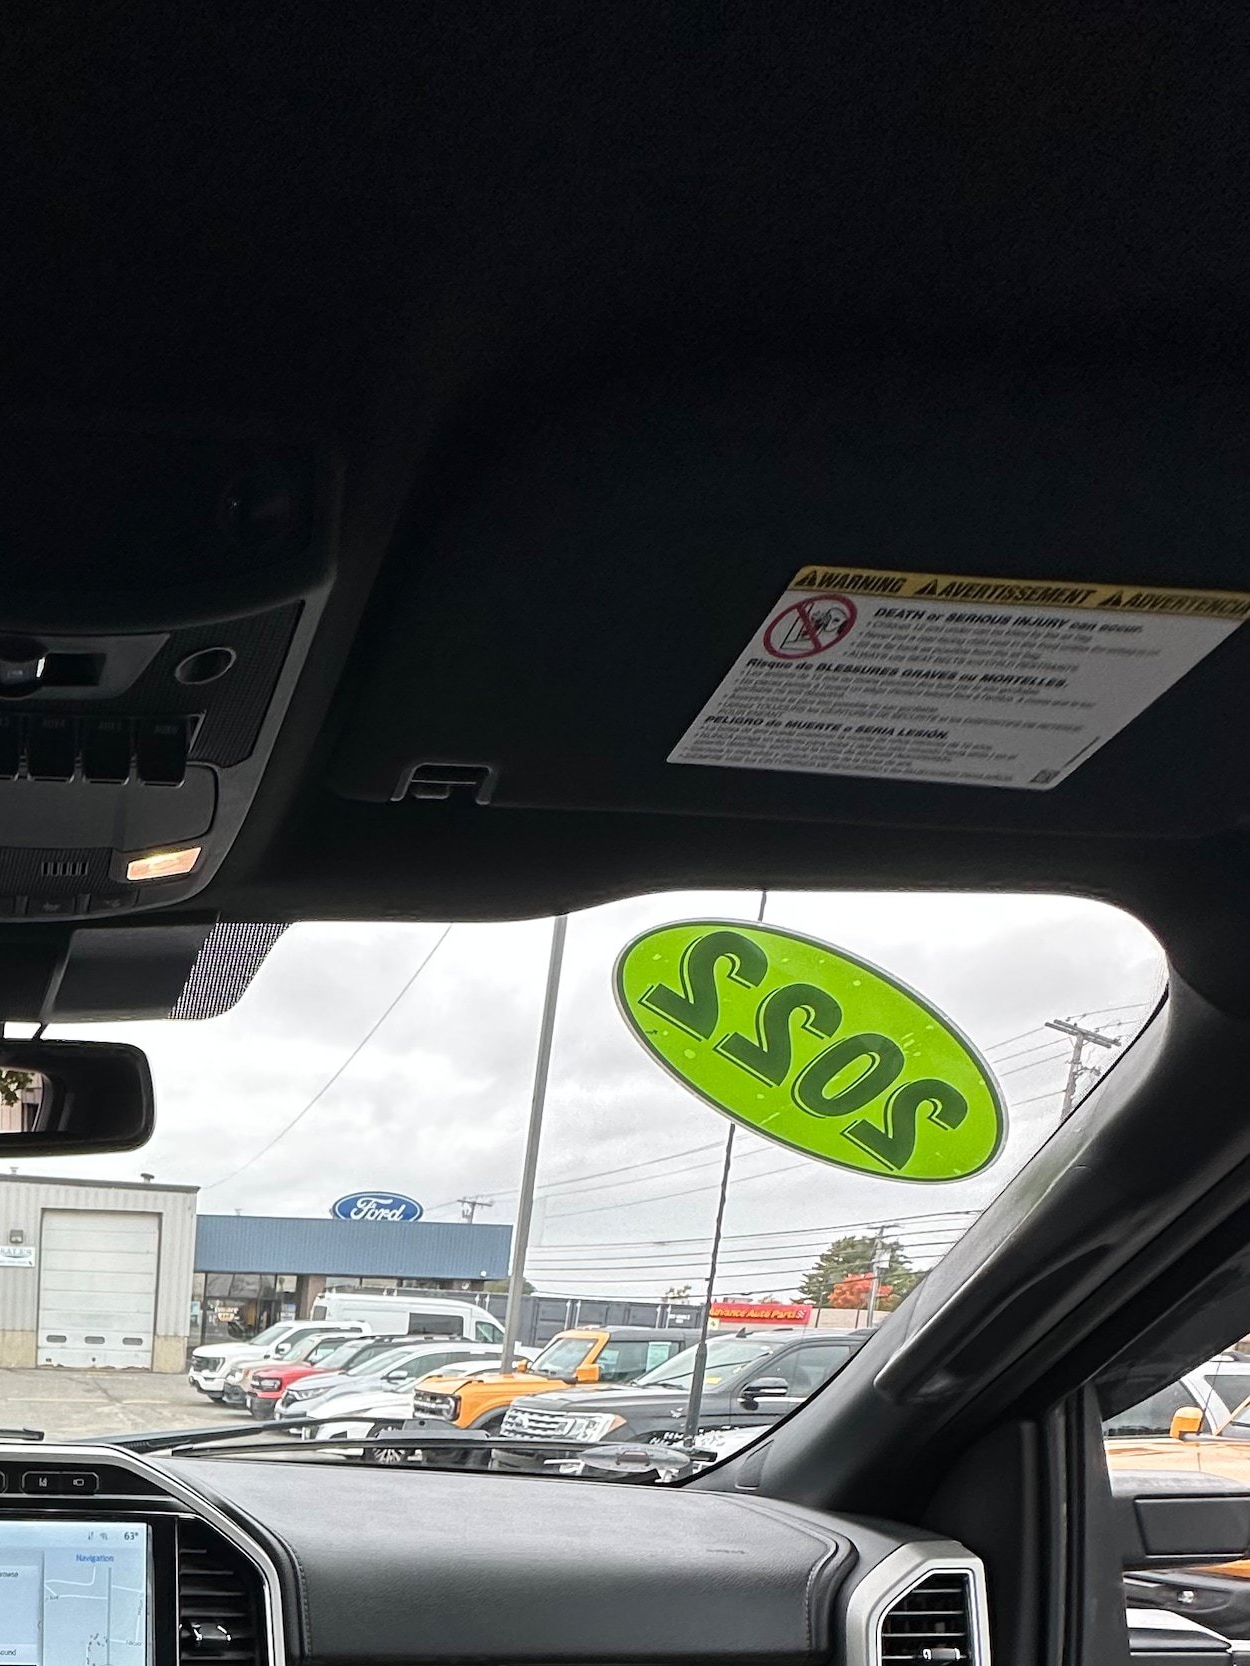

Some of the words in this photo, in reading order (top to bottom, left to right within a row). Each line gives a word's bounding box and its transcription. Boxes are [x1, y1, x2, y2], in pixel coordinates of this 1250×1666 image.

[817, 572, 906, 592] WARNING
[938, 581, 1096, 604] AVERTISSEMENT
[874, 607, 925, 620] DEATH
[927, 612, 944, 621] or
[946, 612, 1012, 626] SERIOUS
[1013, 616, 1070, 630] INJURY
[1070, 621, 1097, 631] can
[746, 658, 793, 671] Risque
[794, 660, 815, 670] de
[816, 661, 900, 677] BLESSURES
[901, 669, 956, 681] GRAVES
[958, 673, 979, 682] ou
[979, 673, 1069, 689] MORTELLES.
[705, 715, 764, 727] PELIGRO
[765, 718, 783, 727] de
[785, 719, 841, 732] MUERTE
[855, 723, 897, 737] SERIA
[897, 726, 949, 741] LESIÓN.
[350, 1197, 406, 1221] Ford
[709, 1306, 745, 1318] Advance
[746, 1307, 771, 1319] Auto
[771, 1309, 798, 1320] Parts
[124, 1532, 140, 1541] 63°
[76, 1554, 115, 1564] Navigation
